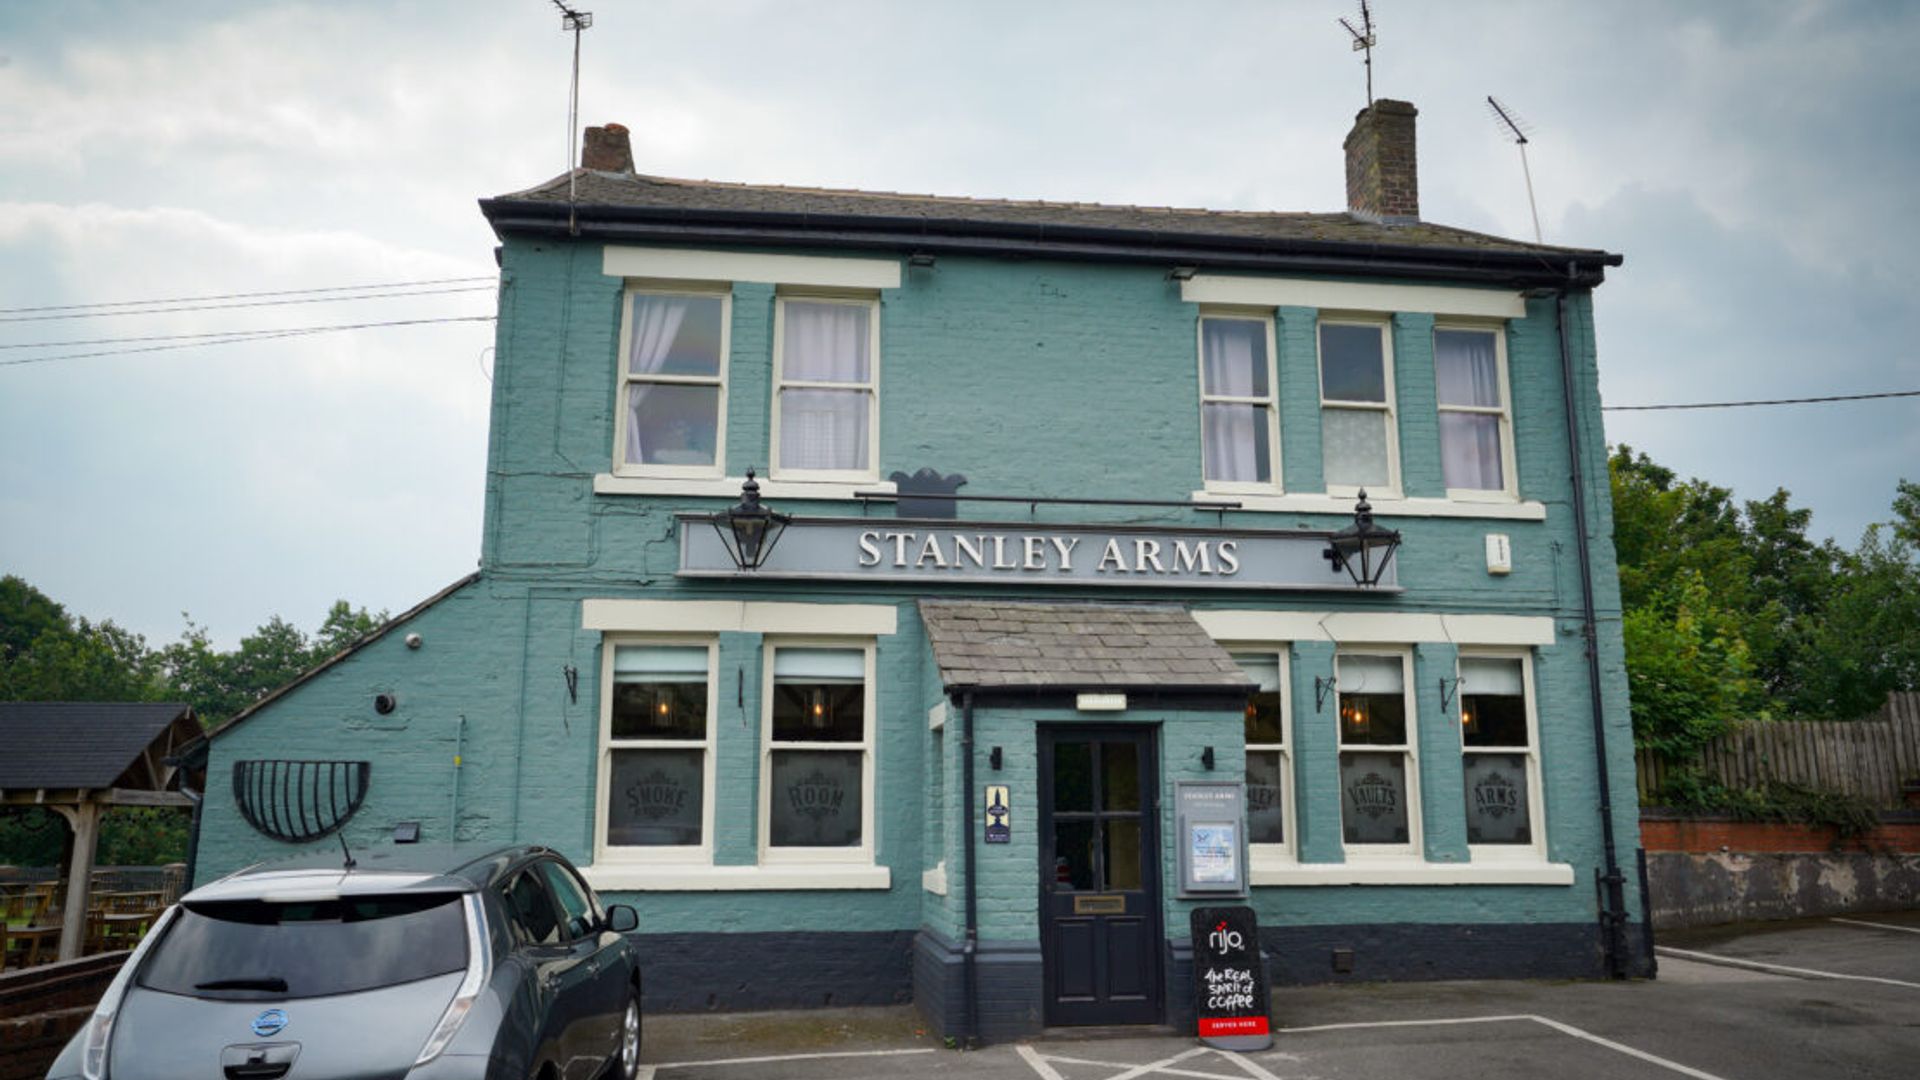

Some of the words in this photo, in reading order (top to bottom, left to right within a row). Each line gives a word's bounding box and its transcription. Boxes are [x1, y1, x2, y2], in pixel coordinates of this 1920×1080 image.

[858, 530, 1080, 571] STANLEY
[1098, 537, 1241, 575] ARMS
[625, 786, 689, 808] SMOKE
[788, 786, 844, 808] ROOM
[1347, 785, 1397, 806] VAULTS
[1475, 786, 1518, 806] ARMS
